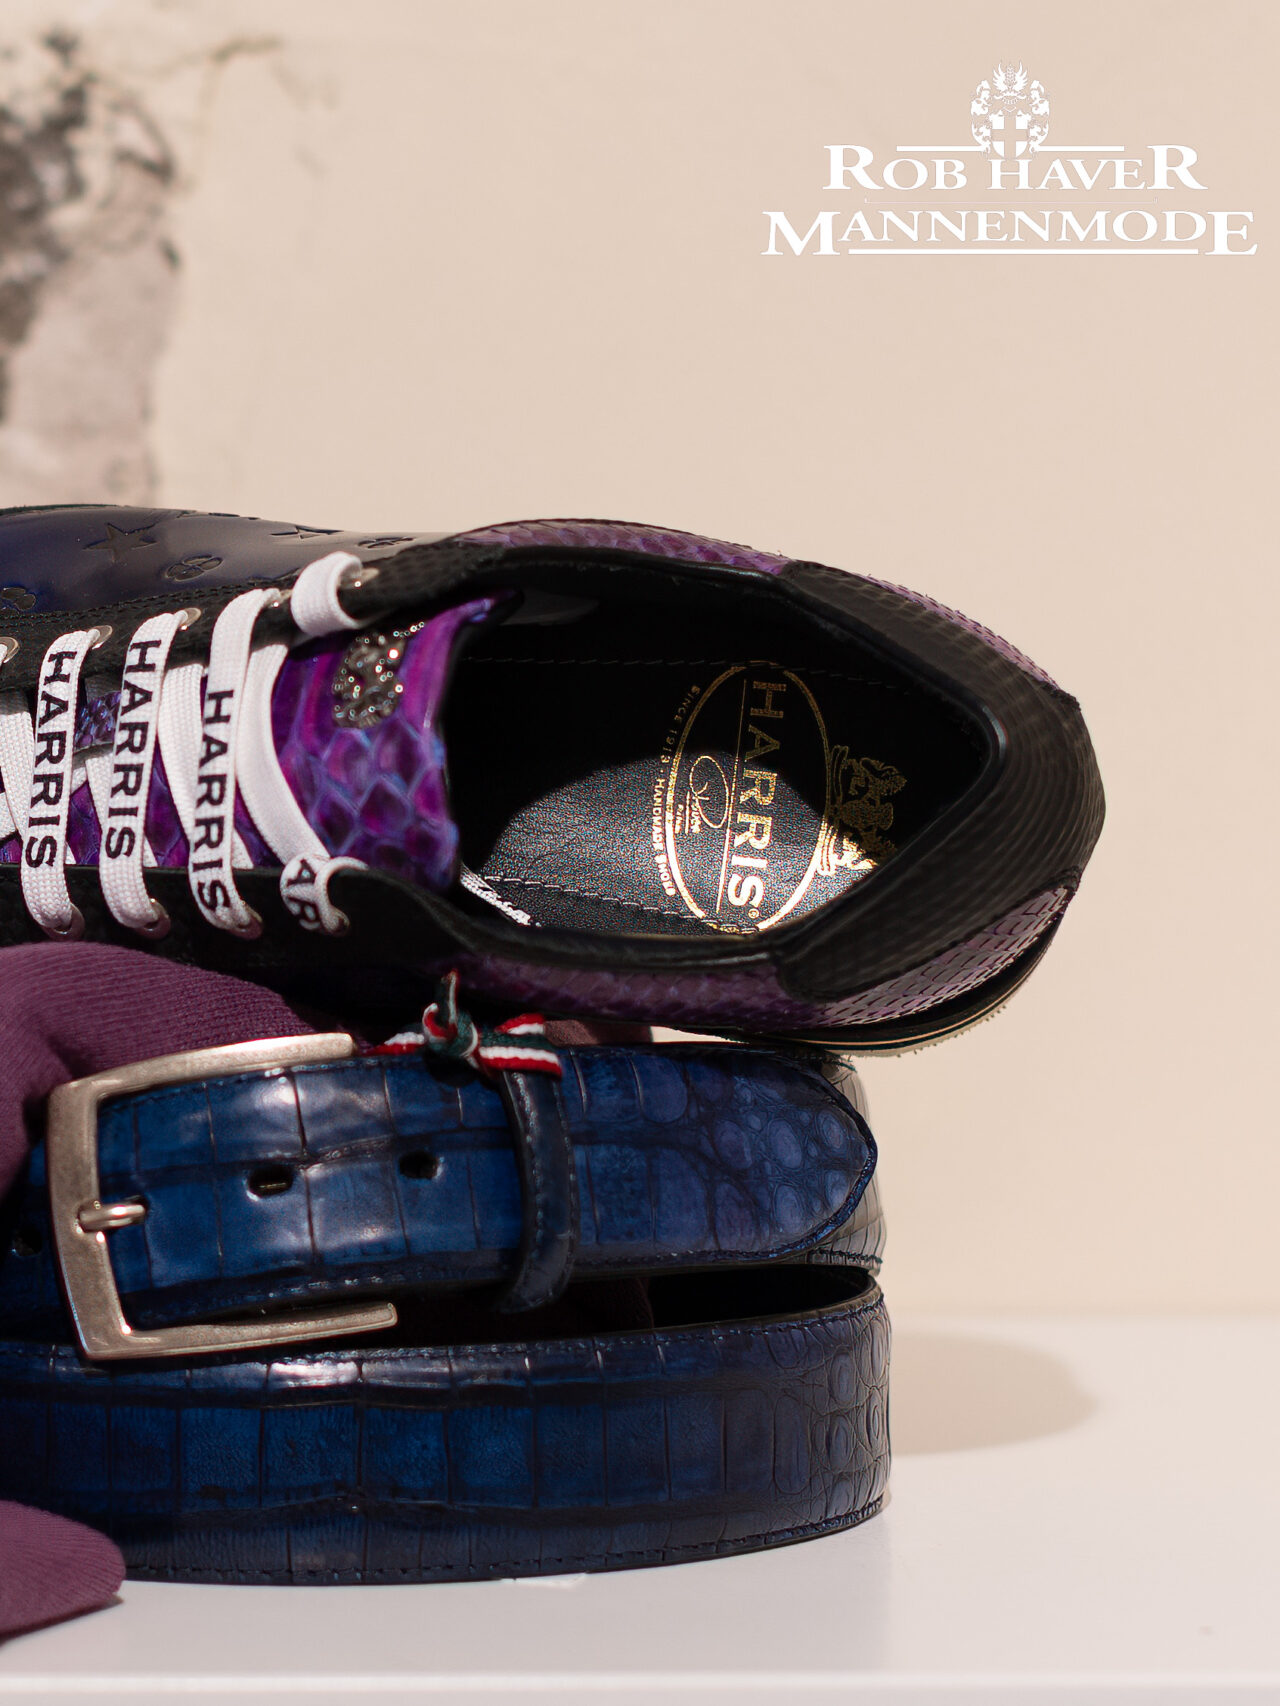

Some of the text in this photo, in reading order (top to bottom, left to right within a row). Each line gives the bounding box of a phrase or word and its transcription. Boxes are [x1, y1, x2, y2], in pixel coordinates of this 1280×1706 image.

[25, 650, 78, 869] HARRIS
[105, 639, 162, 860] HARRIS
[192, 689, 235, 912] HARRIS
[673, 684, 701, 723] SINCE
[726, 680, 788, 908] HARRIS
[651, 777, 669, 852] HANDMADE
[654, 853, 677, 897] SHOES
